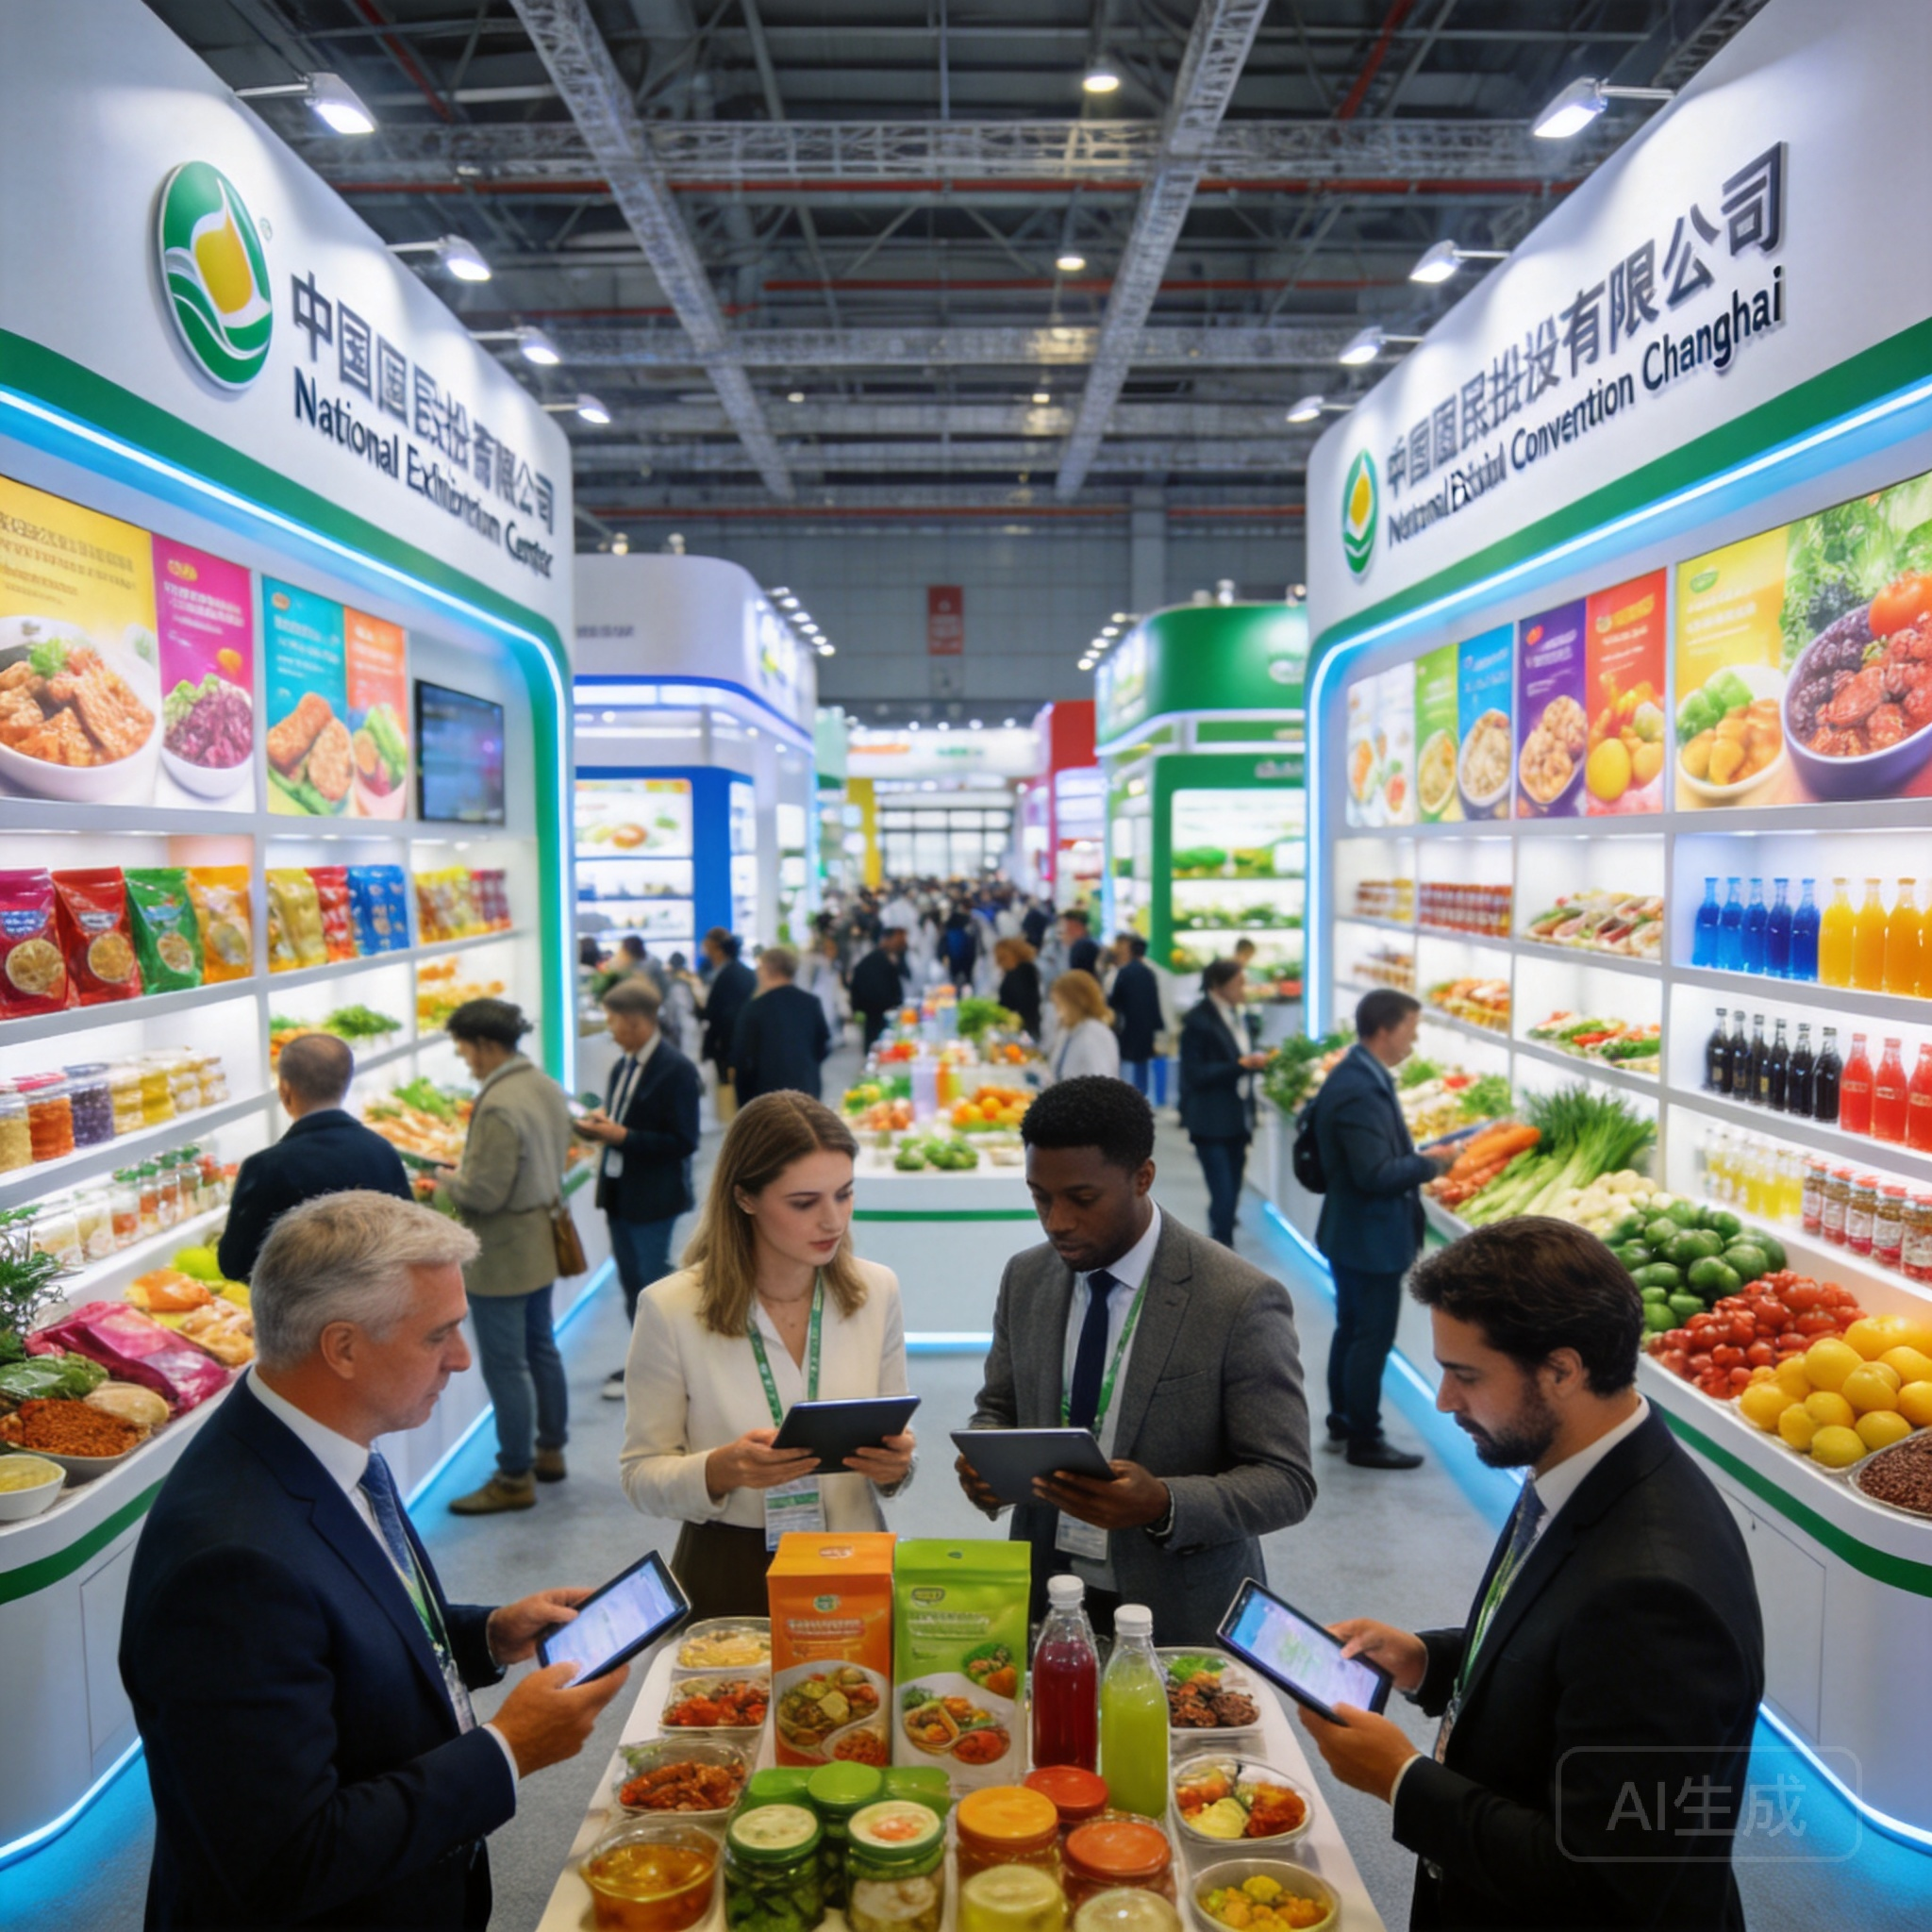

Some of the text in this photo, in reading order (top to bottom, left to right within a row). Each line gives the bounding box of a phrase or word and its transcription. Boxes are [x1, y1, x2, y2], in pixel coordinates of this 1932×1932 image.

[293, 367, 399, 480] National
[1510, 373, 1635, 472] Convention
[1641, 265, 1784, 391] Changhai
